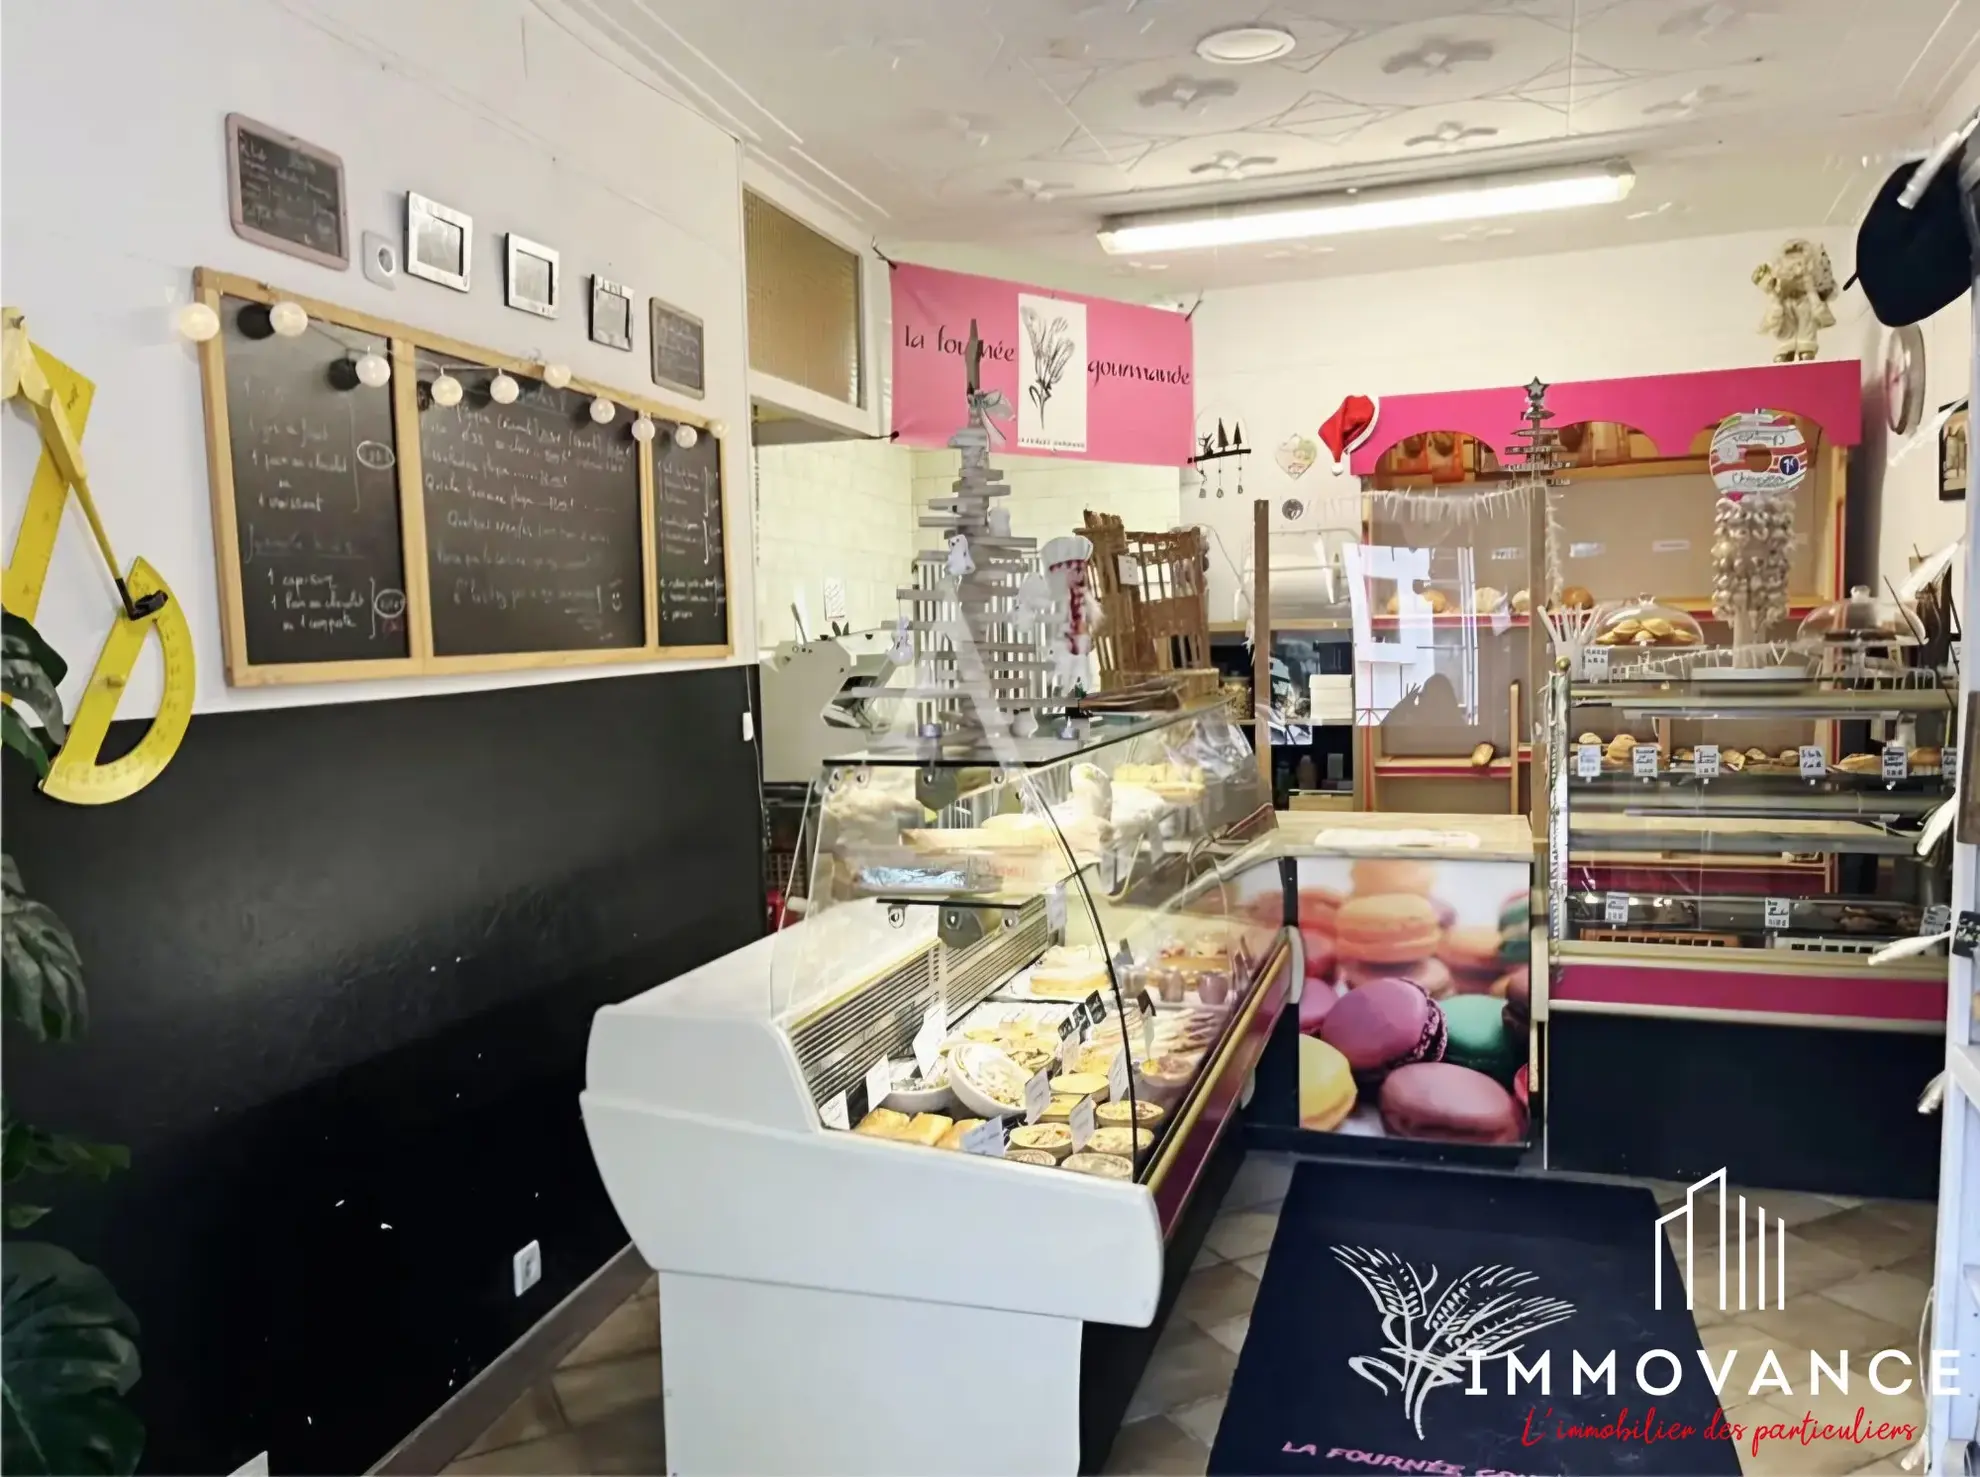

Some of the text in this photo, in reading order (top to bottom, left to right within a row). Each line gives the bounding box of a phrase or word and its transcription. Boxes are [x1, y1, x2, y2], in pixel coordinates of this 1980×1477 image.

[905, 324, 924, 349] la
[1087, 359, 1191, 388] gourmande
[1282, 1441, 1466, 1477] LA FOURNÉE
